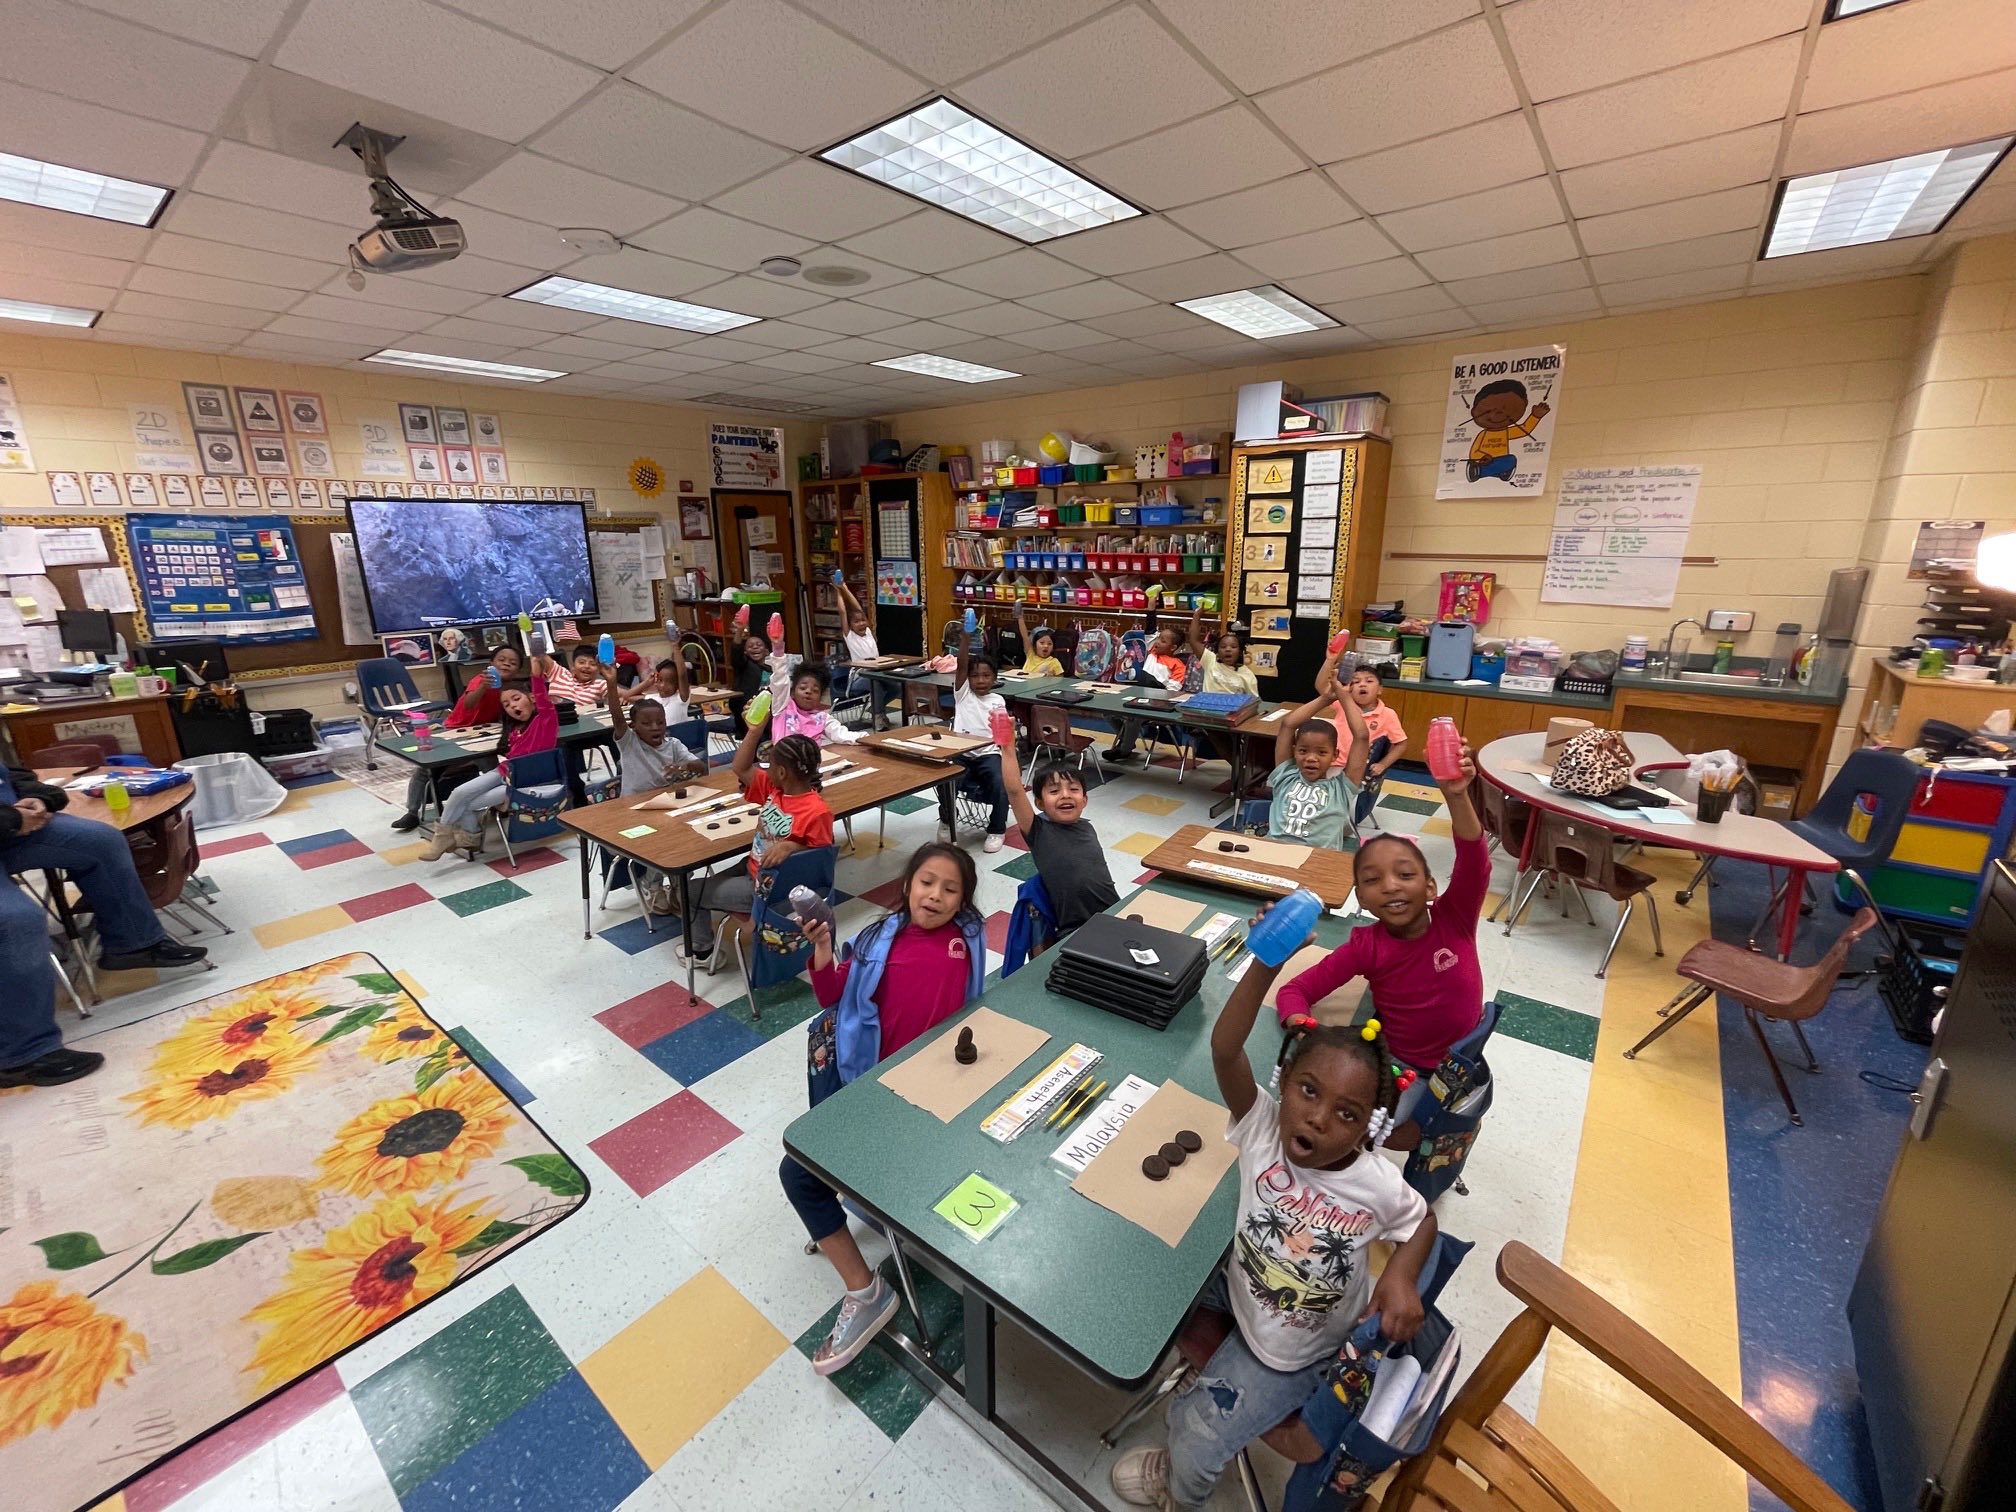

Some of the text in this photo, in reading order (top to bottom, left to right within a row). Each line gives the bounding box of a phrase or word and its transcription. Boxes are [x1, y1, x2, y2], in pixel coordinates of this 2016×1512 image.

[1454, 365, 1467, 379] BE
[1468, 364, 1476, 378] A
[1480, 361, 1508, 376] GOOD
[135, 411, 168, 429] 2D
[138, 434, 182, 448] Shapes
[363, 424, 388, 441] 3D
[1575, 469, 1612, 480] Subject
[1619, 468, 1634, 477] and
[1253, 616, 1265, 631] 5
[1285, 781, 1328, 806] JUST
[1287, 799, 1317, 819] DO
[1066, 1103, 1137, 1166] Malaysia
[953, 1190, 996, 1227] 3
